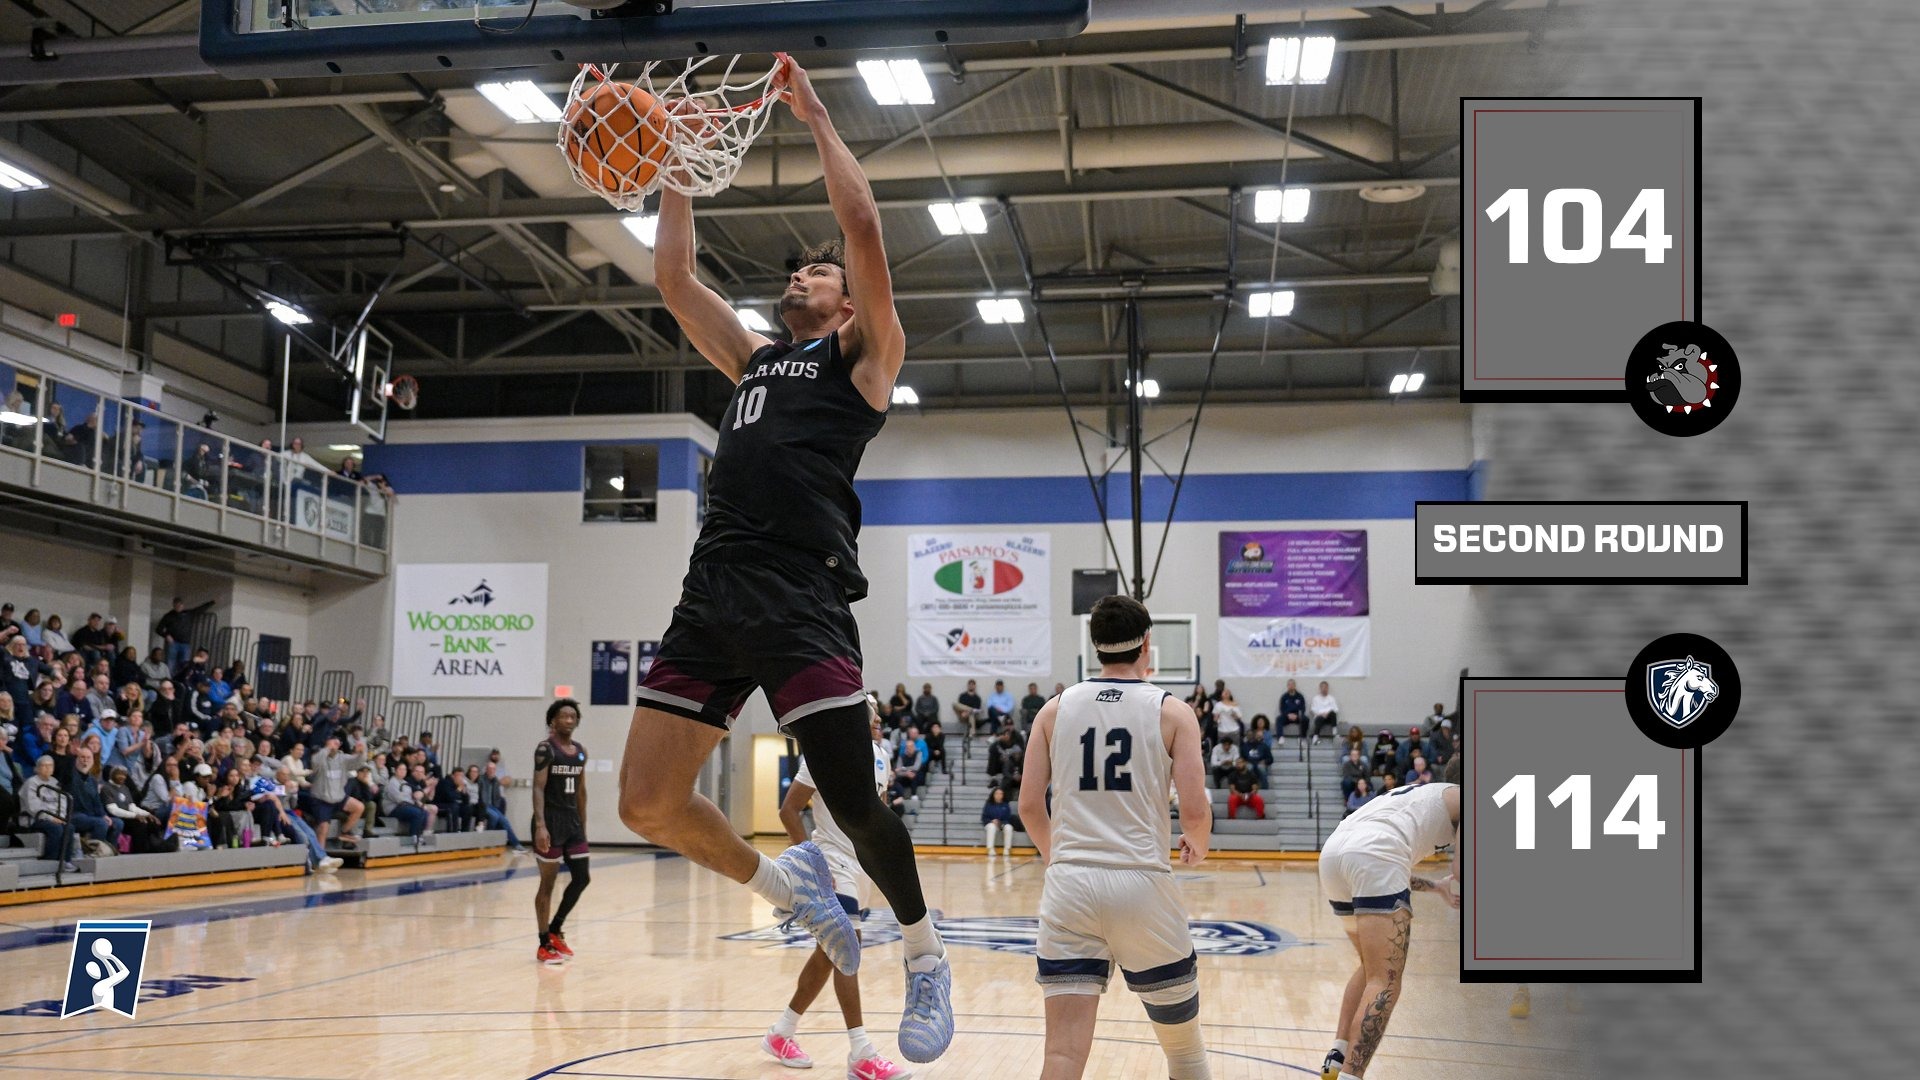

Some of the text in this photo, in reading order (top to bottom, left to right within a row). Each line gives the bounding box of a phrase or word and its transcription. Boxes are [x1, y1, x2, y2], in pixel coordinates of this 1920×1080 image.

[732, 386, 768, 431] 10
[938, 545, 1021, 564] PAISANO'S
[407, 611, 535, 631] WOODSBORO
[444, 634, 494, 653] BANK
[972, 637, 1013, 645] SPORTS
[1248, 637, 1342, 648] ALL IN ONE
[432, 658, 503, 675] ARENA
[1079, 726, 1133, 792] 12
[564, 777, 576, 794] 11
